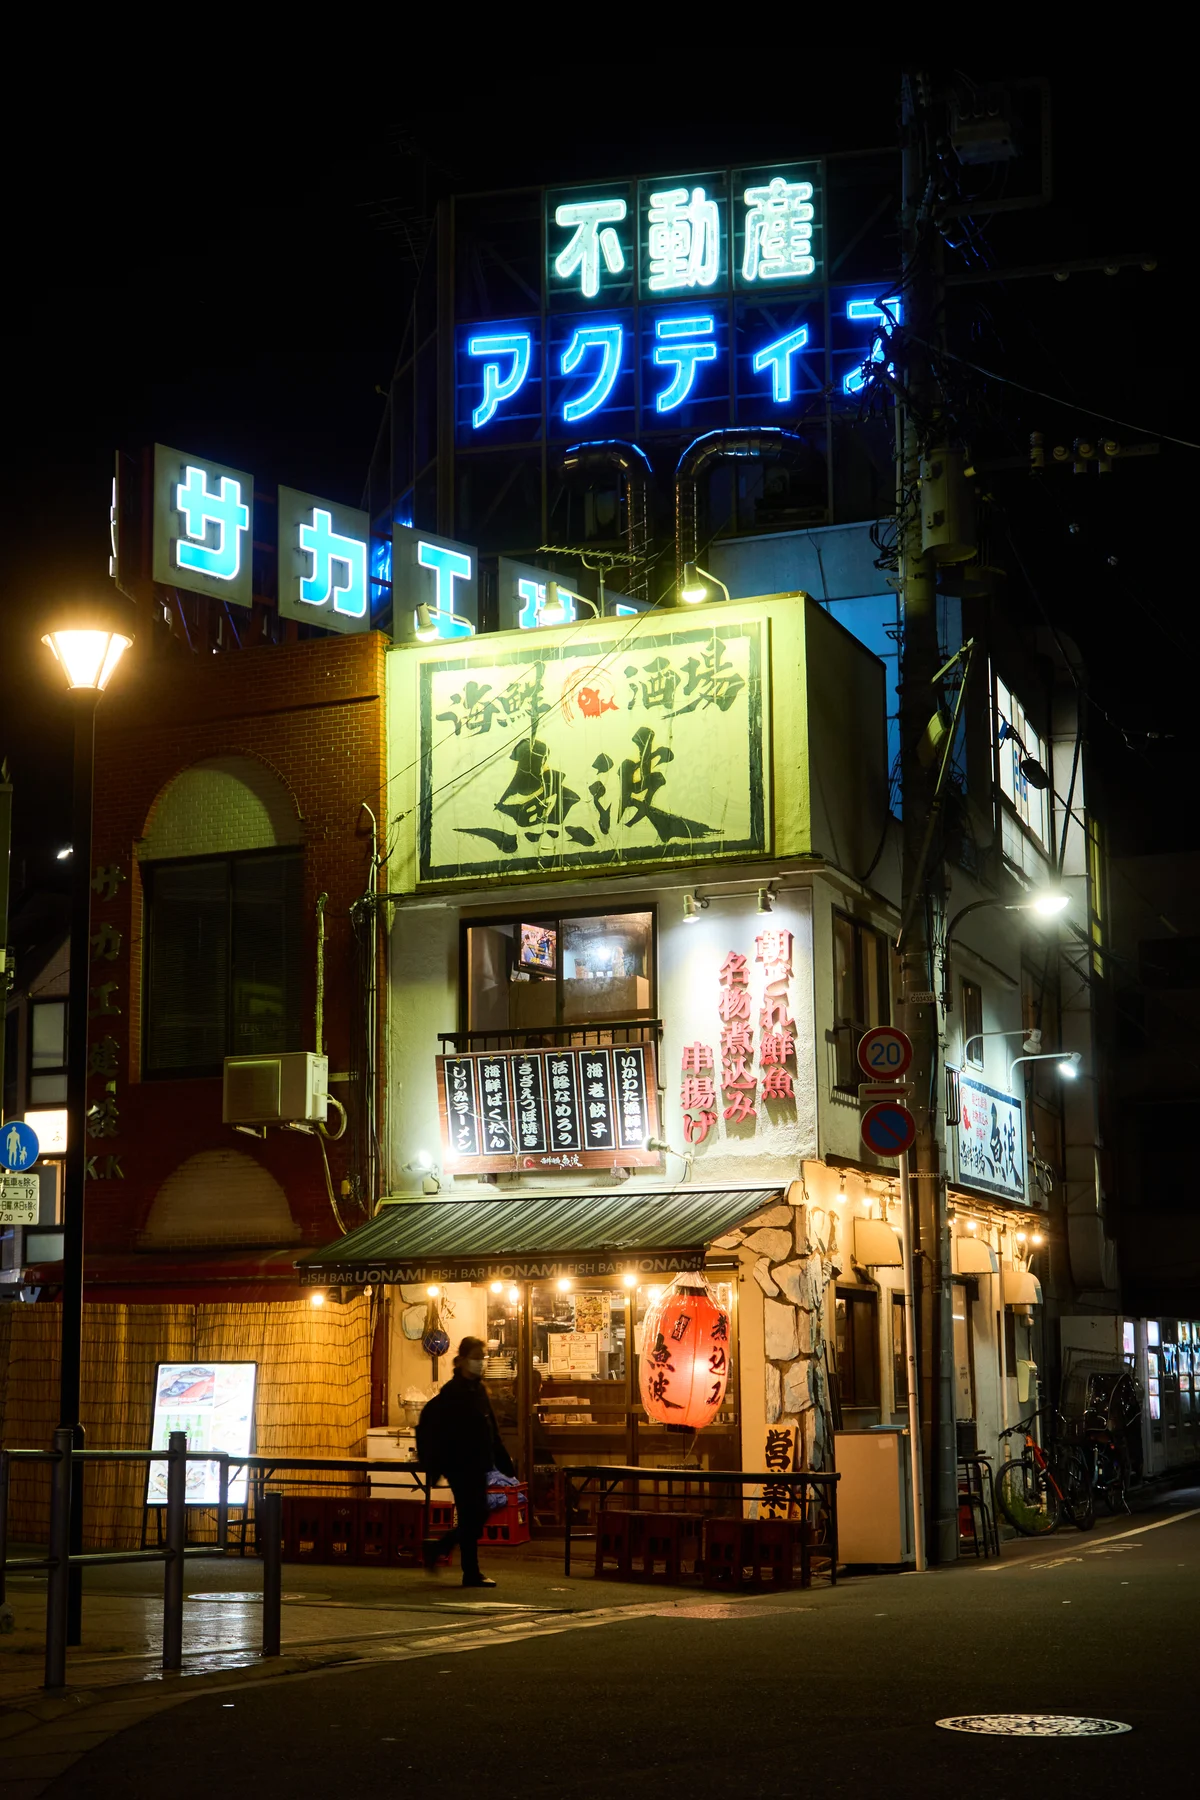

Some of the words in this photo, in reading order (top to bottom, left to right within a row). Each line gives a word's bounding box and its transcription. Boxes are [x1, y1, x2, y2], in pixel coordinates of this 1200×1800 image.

[555, 176, 815, 298] 不動産
[436, 661, 550, 744] 海鮮
[624, 637, 745, 720] 酒場
[453, 727, 725, 853] 魚波
[718, 950, 757, 1123] 名物煮込み
[870, 1042, 900, 1066] 20
[453, 1066, 472, 1151] しじみラーメン
[484, 1064, 506, 1149] 海鮮ばくだん
[518, 1062, 538, 1147] さざえつぼ焼き
[586, 1062, 608, 1138] 海老餃子
[680, 1041, 718, 1145] 串揚げ
[983, 1102, 1023, 1189] 魚波
[25, 1189, 34, 1199] 19
[329, 1272, 353, 1283] BAR
[355, 1268, 427, 1283] UONAMI
[431, 1268, 458, 1281] FISH
[461, 1268, 485, 1279] BAR
[488, 1263, 563, 1278] UONAMI
[568, 1263, 595, 1274] FISH
[599, 1261, 624, 1273] BAR
[646, 1332, 685, 1409] 魚波
